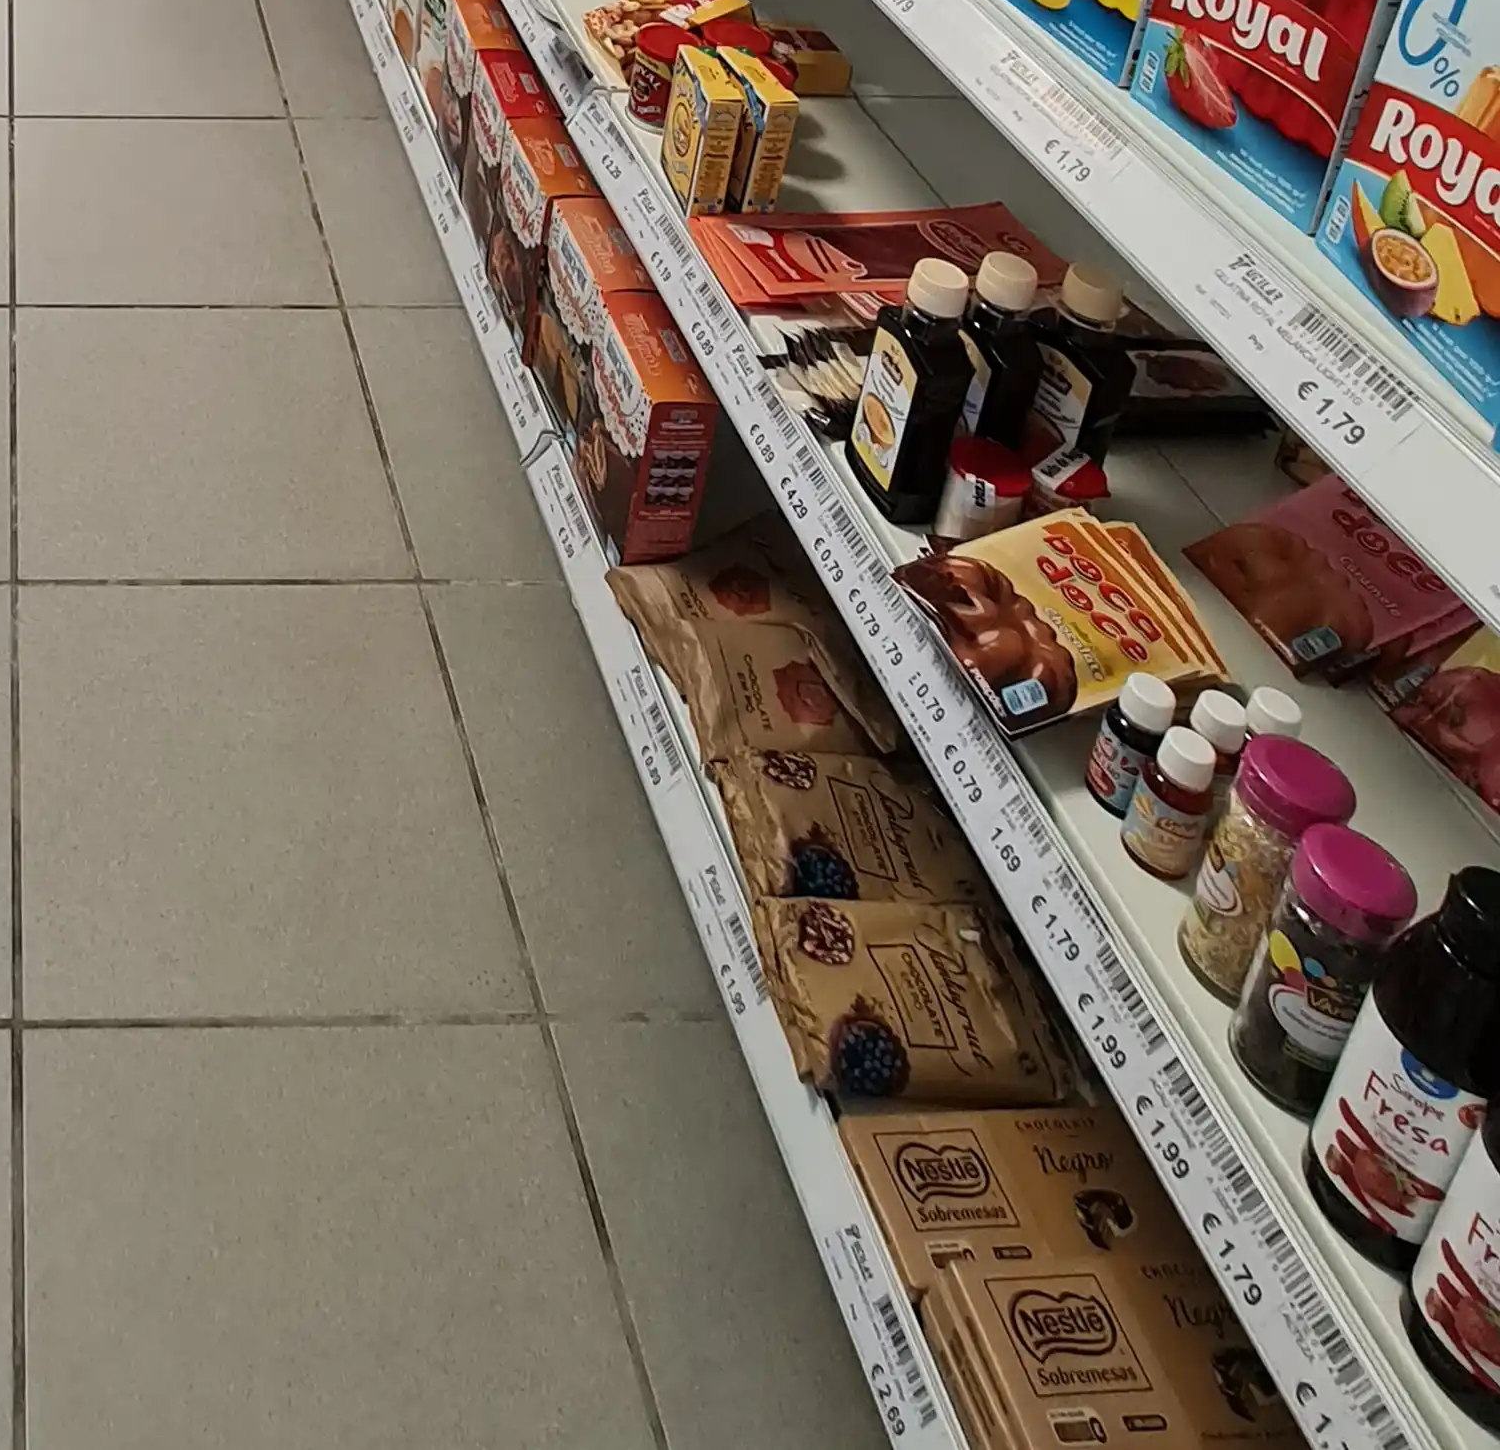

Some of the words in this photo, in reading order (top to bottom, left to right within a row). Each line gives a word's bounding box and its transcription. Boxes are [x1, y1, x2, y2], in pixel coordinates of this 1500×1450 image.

[1043, 138, 1059, 156] €
[1369, 97, 1500, 225] Roya
[1297, 381, 1318, 401] €
[1314, 399, 1366, 446] 1,79
[1339, 554, 1401, 618] Caramelo
[743, 652, 775, 733] CHOCOLATE
[943, 742, 957, 760] €
[953, 755, 984, 804] 0.79
[988, 827, 1023, 873] 1.69
[1030, 894, 1046, 915] €
[1042, 908, 1081, 963] 1,79
[901, 951, 946, 1038] CHOCOLATE
[1076, 992, 1093, 1013] €
[1089, 1009, 1128, 1070] 1,99
[1135, 1094, 1154, 1116] €
[1149, 1121, 1192, 1180] 1,99
[1363, 1069, 1450, 1157] Fresa
[906, 1153, 981, 1184] Nestlé
[1032, 1143, 1116, 1186] Negro
[919, 1202, 1008, 1224] Sobremesas
[1201, 1212, 1222, 1235] €
[1216, 1239, 1264, 1307] 1,79
[1018, 1303, 1107, 1340] Nestlé
[1037, 1363, 1139, 1388] Sobremesas
[1295, 1381, 1318, 1406] €
